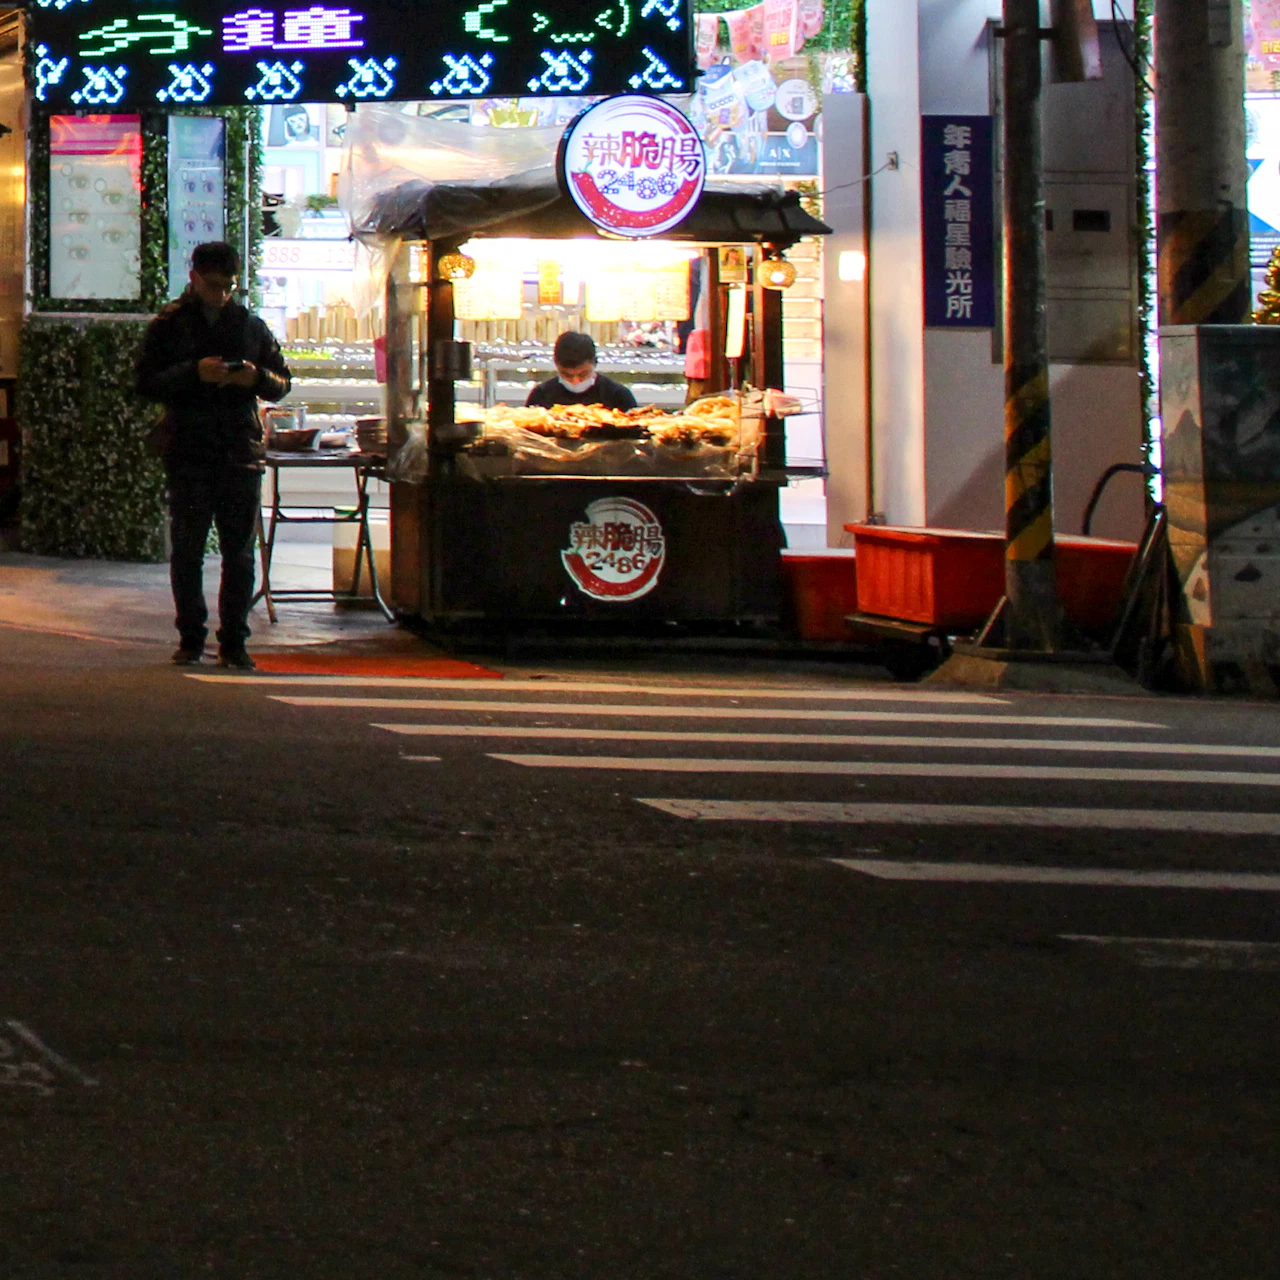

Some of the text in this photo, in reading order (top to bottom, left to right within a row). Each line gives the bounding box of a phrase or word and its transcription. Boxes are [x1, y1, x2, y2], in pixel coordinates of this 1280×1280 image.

[581, 130, 701, 177] 辣脆腸
[597, 169, 679, 200] 2486
[585, 551, 646, 574] 2486
